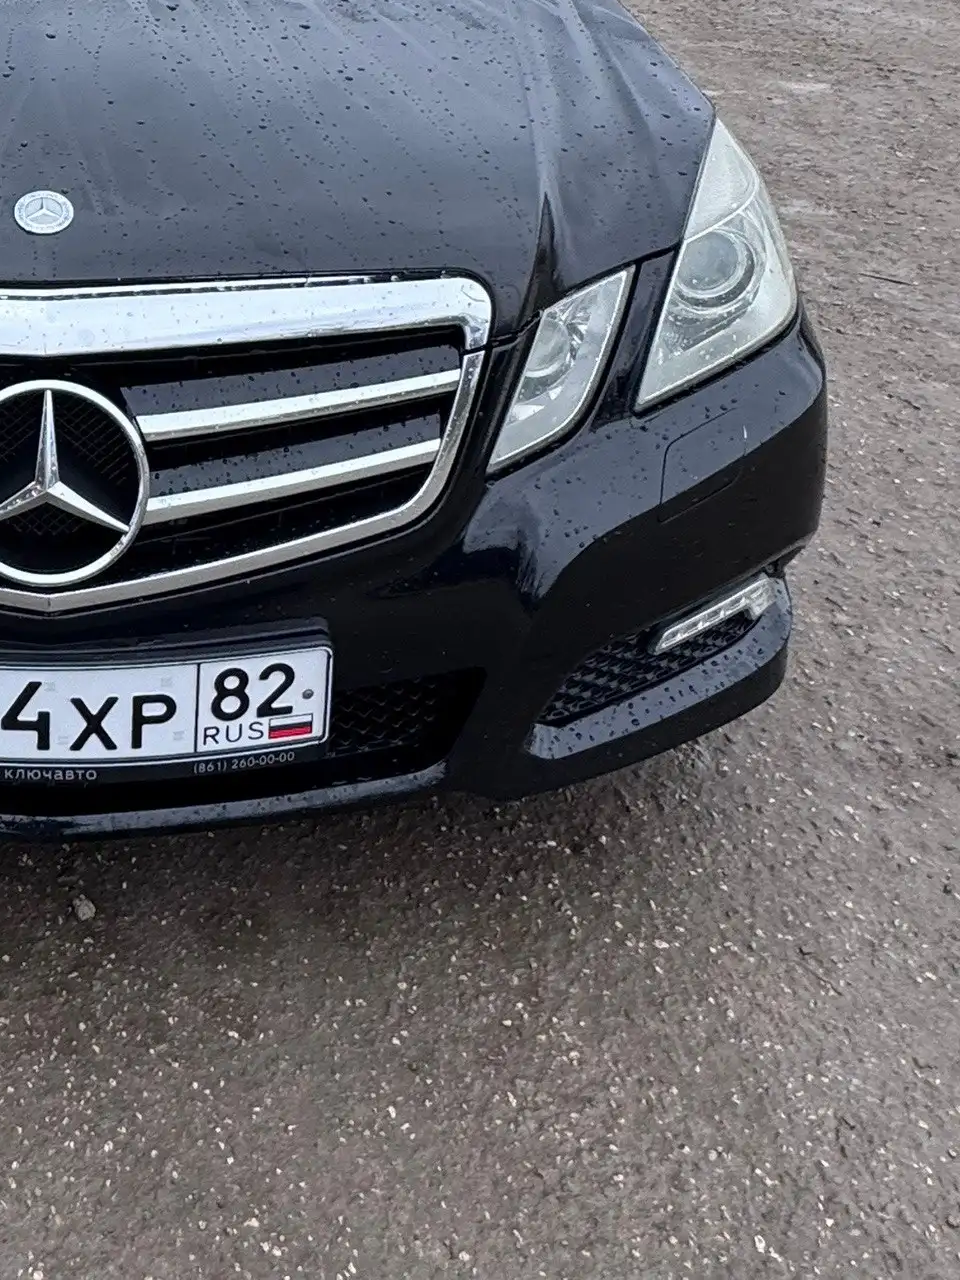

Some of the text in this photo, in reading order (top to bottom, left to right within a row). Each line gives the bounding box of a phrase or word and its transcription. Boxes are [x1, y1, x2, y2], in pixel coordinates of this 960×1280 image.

[210, 662, 296, 721] 82
[202, 720, 265, 746] RUS
[193, 751, 296, 775] (861) 260-00-00
